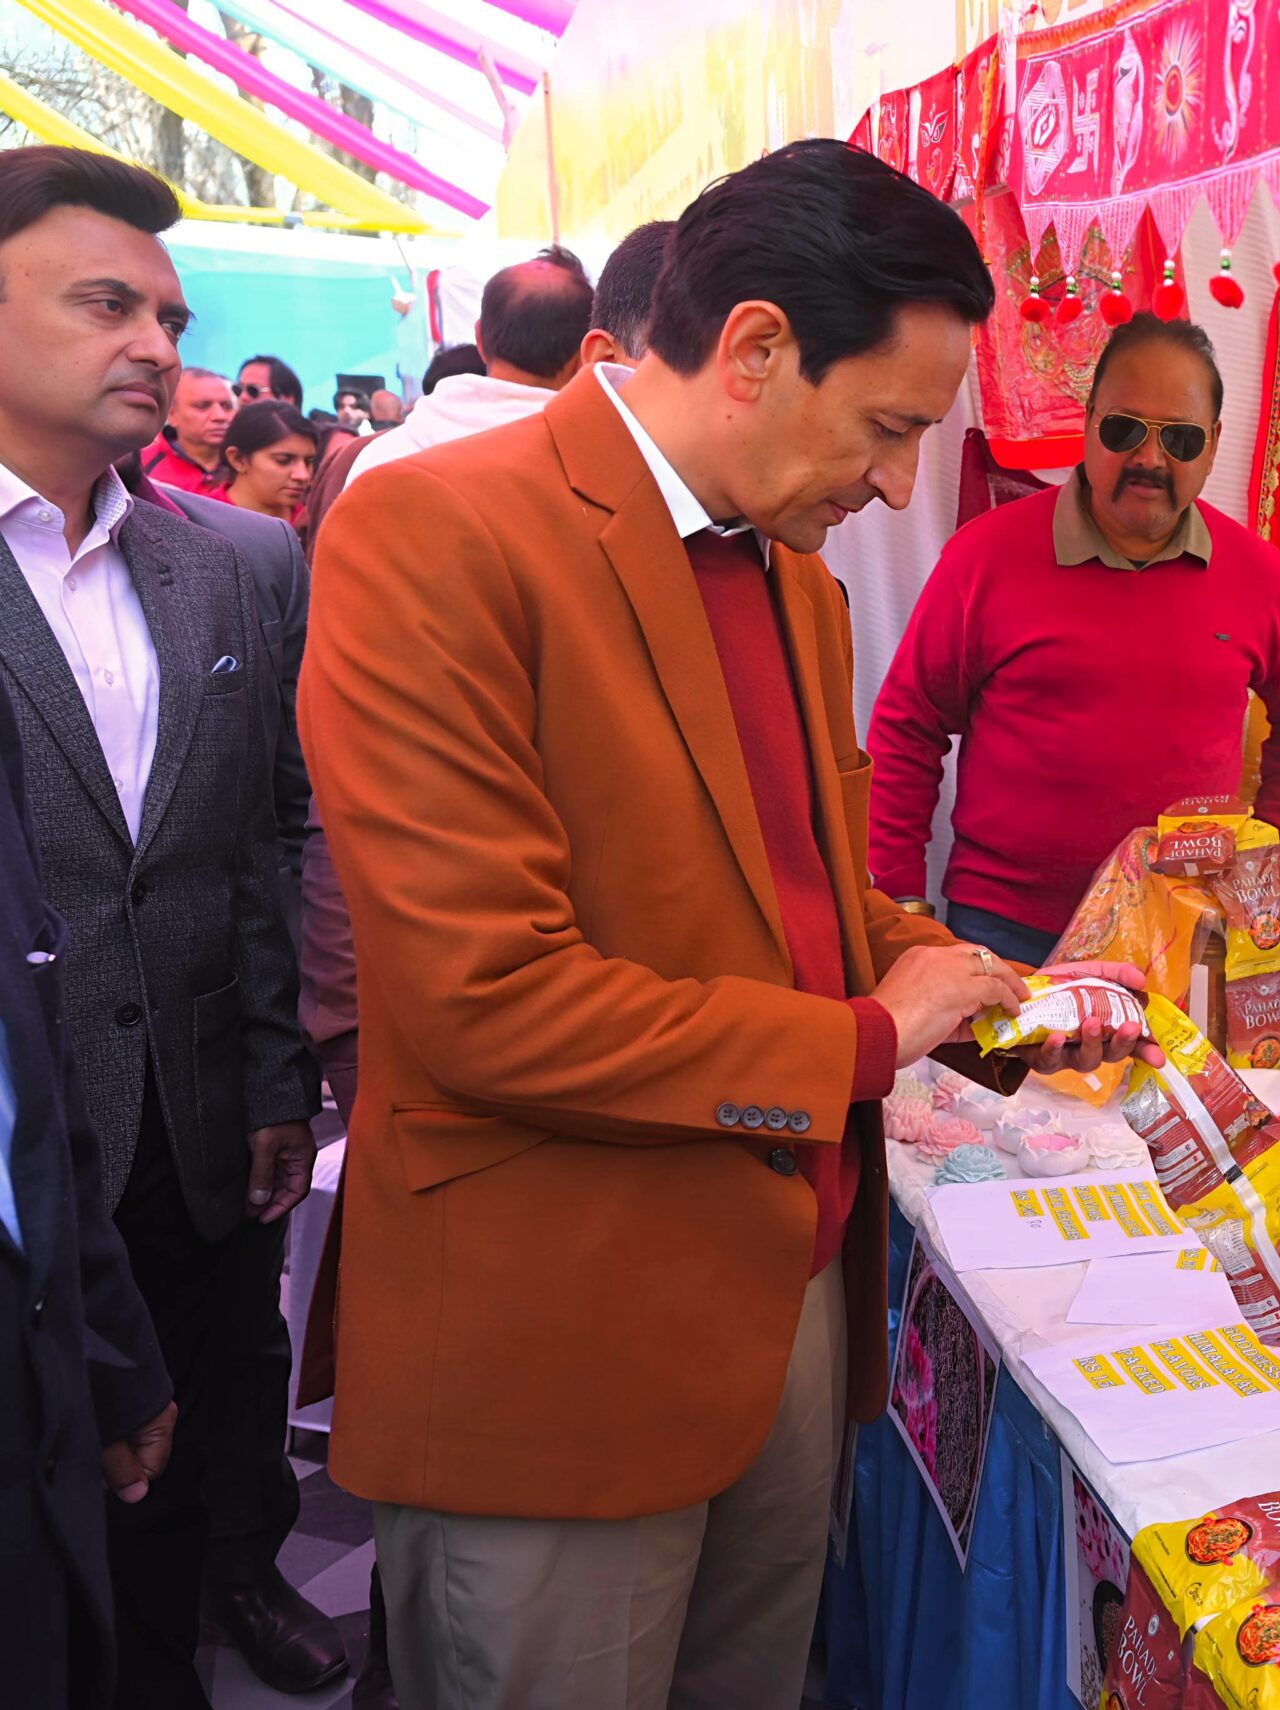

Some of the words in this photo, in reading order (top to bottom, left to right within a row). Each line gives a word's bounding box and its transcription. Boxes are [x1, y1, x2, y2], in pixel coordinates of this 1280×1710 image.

[1170, 837, 1222, 849] BOWL
[1171, 848, 1221, 858] PAHADI
[1232, 872, 1274, 890] PAHADI
[1236, 885, 1280, 903] BOWL
[1077, 1355, 1102, 1374] RS
[1095, 1374, 1117, 1390] 15
[1116, 1347, 1167, 1395] PACKED
[1154, 1339, 1211, 1391] FLAVORS
[1187, 1332, 1263, 1397] HIMALAYAN
[1119, 1633, 1147, 1707] BOWL
[1124, 1615, 1161, 1685] PAHADI
